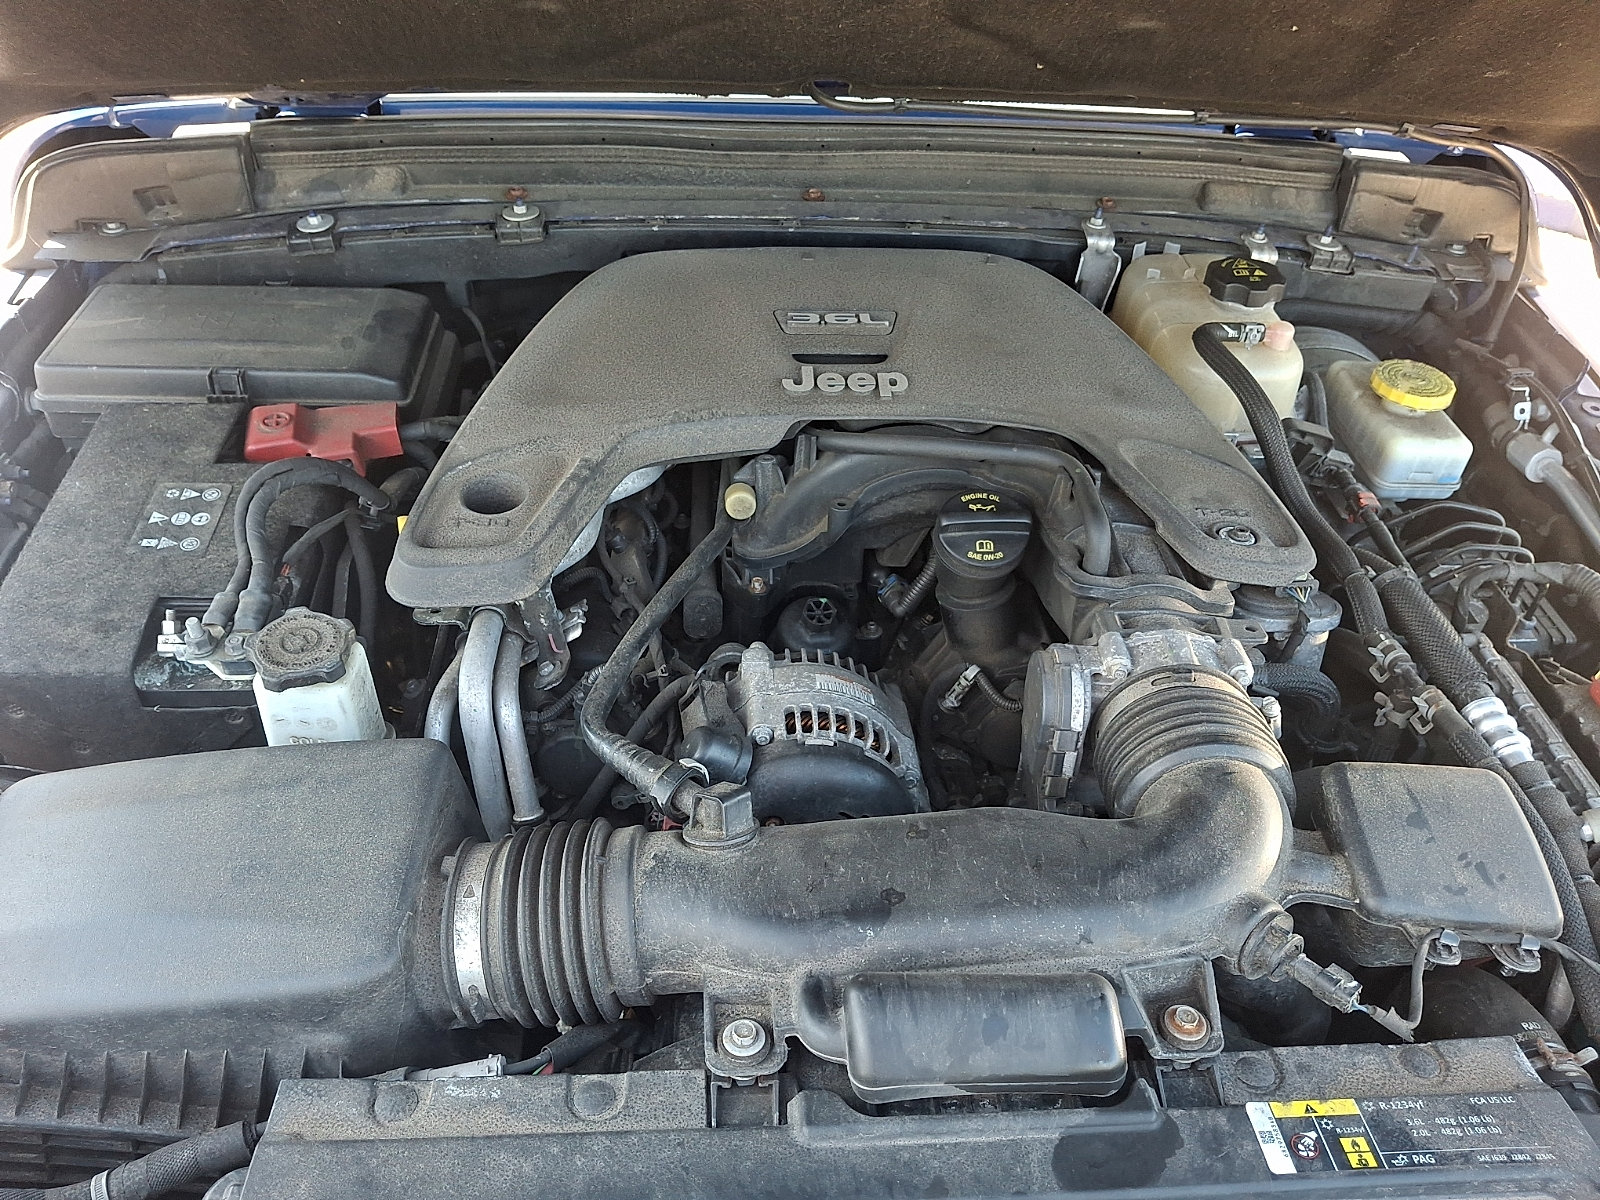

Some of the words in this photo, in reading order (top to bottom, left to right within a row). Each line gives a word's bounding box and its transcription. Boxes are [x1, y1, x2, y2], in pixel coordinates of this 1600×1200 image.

[786, 312, 889, 326] 3.6L
[781, 365, 909, 397] Jeep
[960, 492, 988, 503] ENGINE
[988, 494, 1001, 503] OIL
[967, 551, 983, 561] SAE
[983, 551, 1004, 561] 0W-20
[1521, 1021, 1541, 1031] RAD
[1379, 1099, 1424, 1111] R-1234yf
[1469, 1097, 1488, 1105] FCA
[1487, 1096, 1500, 1104] US
[1499, 1095, 1516, 1104] LLC
[1405, 1118, 1426, 1127] 3.6L
[1434, 1116, 1457, 1126] 482g
[1457, 1114, 1481, 1125] (1.06
[1411, 1128, 1432, 1138] 2.0L
[1440, 1127, 1463, 1137] 482g
[1463, 1125, 1488, 1136] (1.06
[1412, 1154, 1437, 1165] PAG
